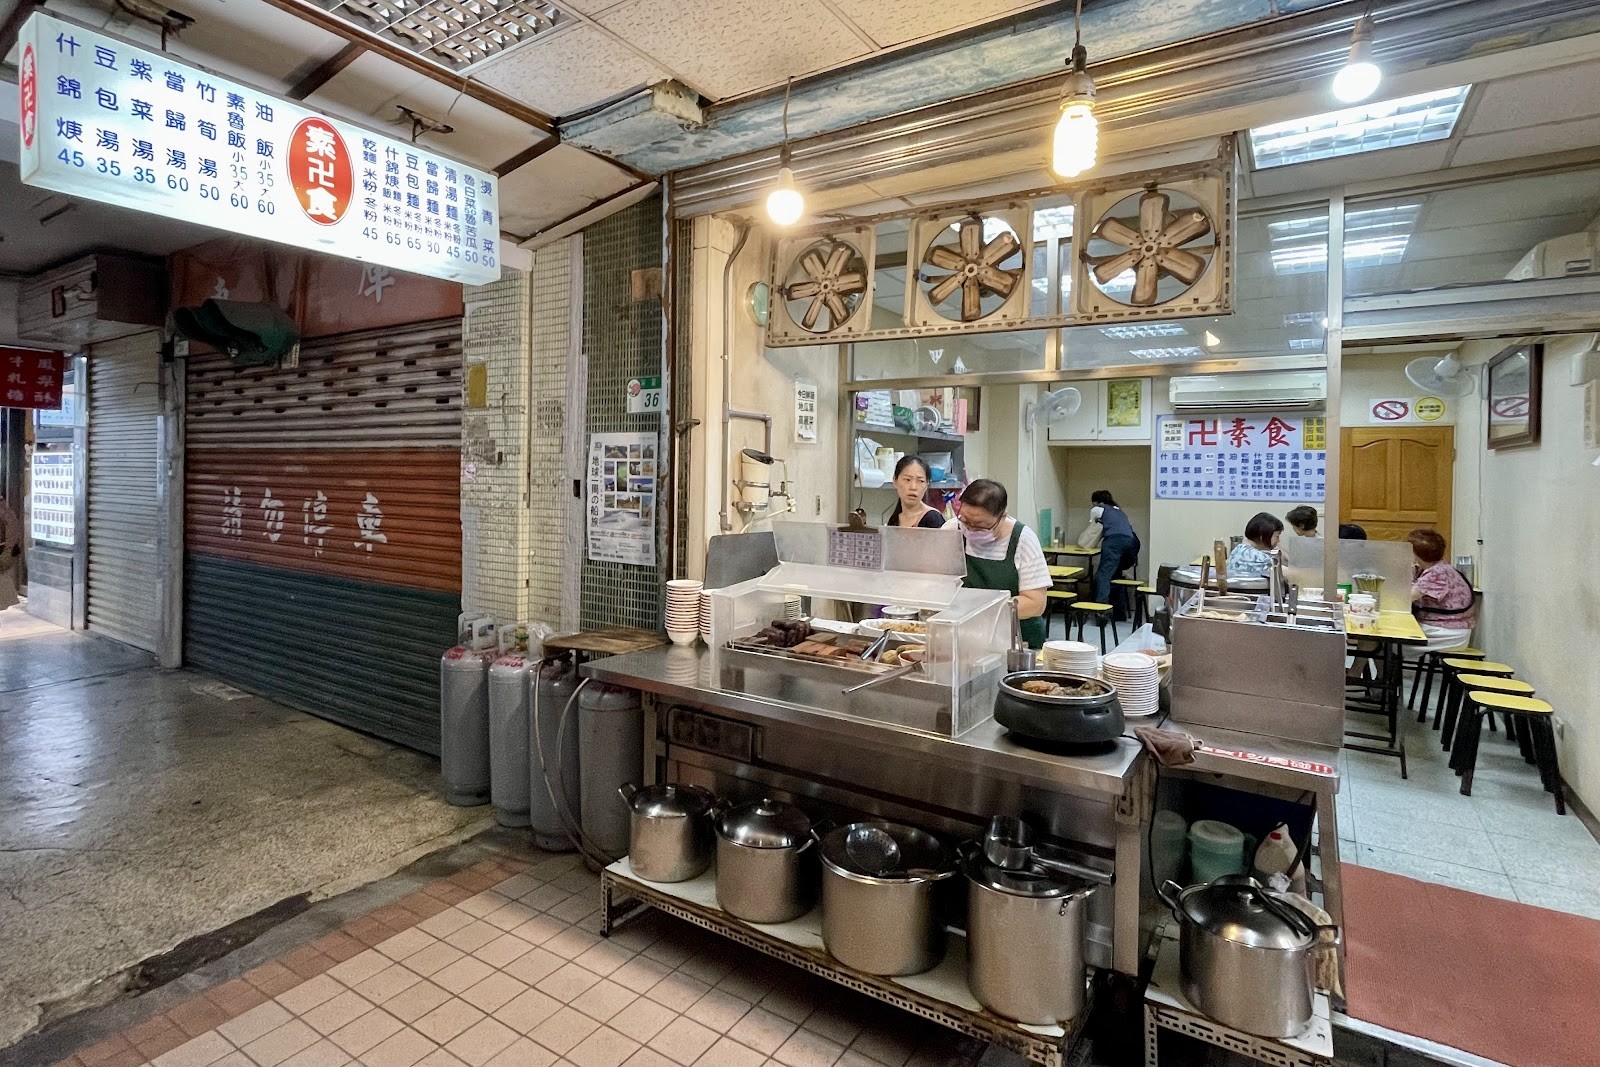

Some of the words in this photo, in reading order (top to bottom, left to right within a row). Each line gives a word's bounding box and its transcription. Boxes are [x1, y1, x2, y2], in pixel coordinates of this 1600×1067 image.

[94, 45, 120, 152] 豆包湯
[130, 58, 154, 162] 紫菜湯
[164, 70, 187, 171] 當歸湯
[227, 92, 246, 150] 素魯飯
[196, 80, 218, 179] 竹筍湯
[255, 101, 274, 159] 油飯
[57, 148, 85, 168] 45
[232, 152, 244, 162] 小
[260, 160, 271, 170] 小
[97, 157, 122, 177] 35
[133, 167, 156, 184] 35
[230, 164, 248, 180] 35
[167, 175, 189, 192] 60
[257, 171, 274, 187] 35
[363, 168, 377, 193] 米粉
[405, 153, 420, 210] 豆包麵
[425, 160, 440, 215] 當歸麵
[199, 184, 220, 201] 50
[231, 193, 248, 209] 60
[445, 166, 458, 221] 清湯麵
[258, 199, 275, 215] 60
[364, 197, 378, 223] 冬粉
[362, 226, 379, 240] 45
[386, 231, 401, 246] 65
[407, 237, 421, 250] 65
[446, 246, 460, 259] 45
[465, 250, 479, 264] 50
[482, 255, 495, 268] 50
[644, 392, 660, 408] 36
